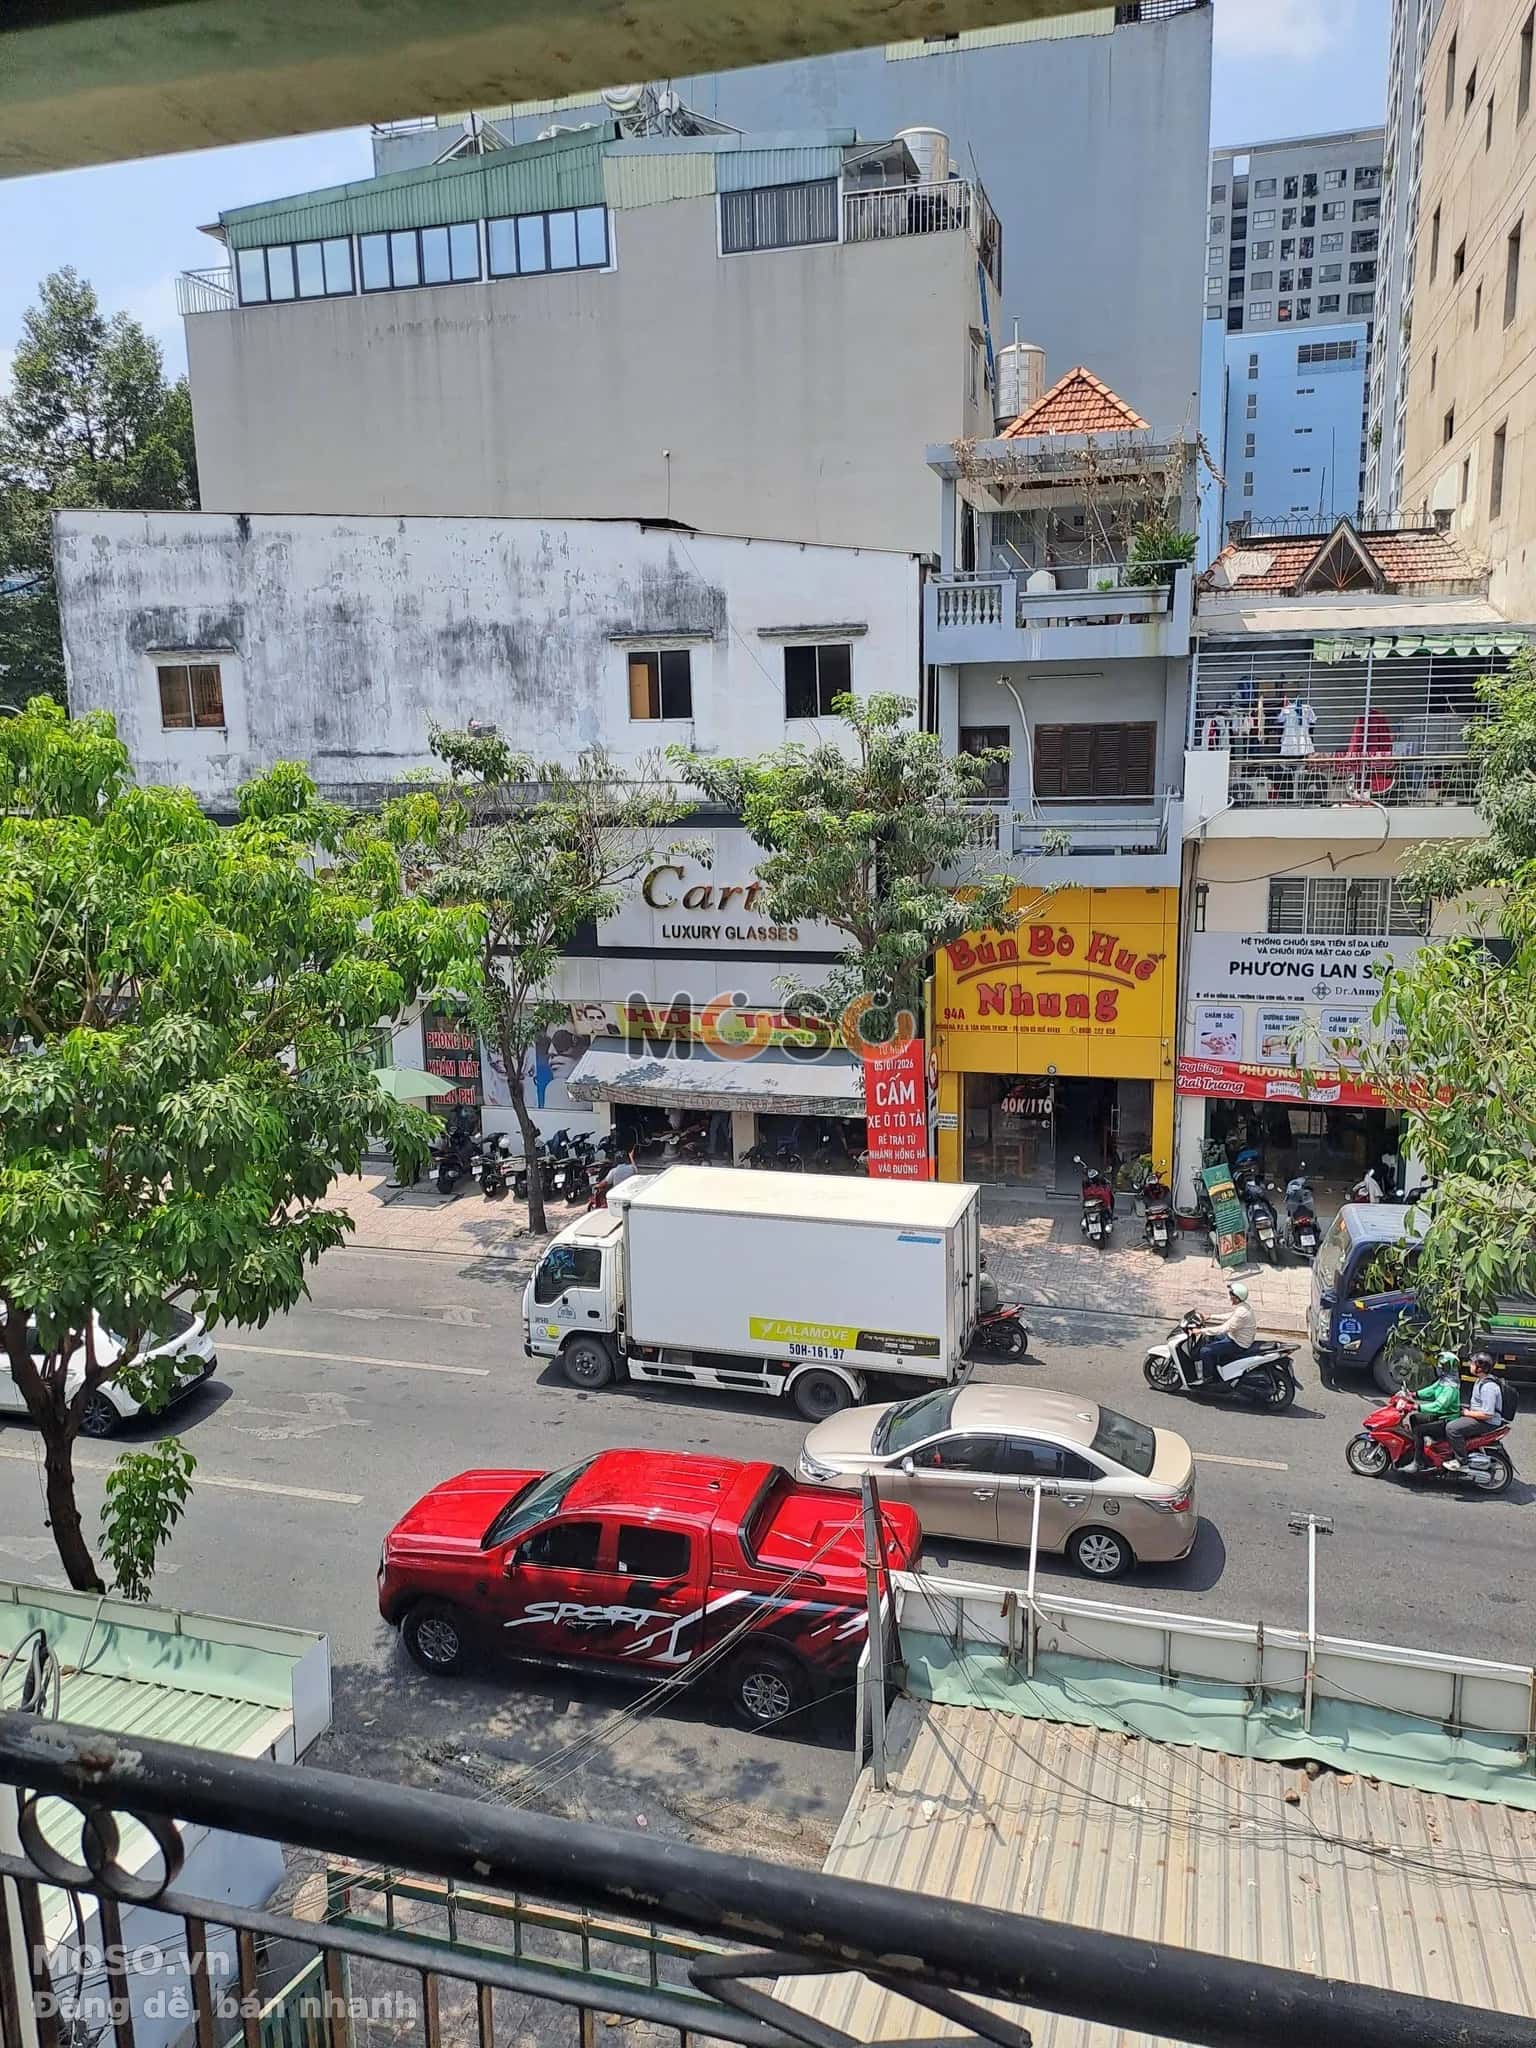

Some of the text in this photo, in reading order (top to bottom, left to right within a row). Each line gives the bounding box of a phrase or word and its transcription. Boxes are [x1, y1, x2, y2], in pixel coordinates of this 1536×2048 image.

[642, 864, 763, 913] Cart
[662, 924, 799, 942] LUXURY GLASSES
[1254, 937, 1281, 946] THỐNG
[1310, 939, 1326, 947] SPA
[1358, 940, 1369, 949] DA
[946, 924, 1167, 982] Bún Bò Huế
[1229, 961, 1314, 977] PHƯƠNG
[1320, 964, 1357, 979] LAN
[976, 983, 1119, 1023] Nhung
[943, 1007, 965, 1020] 94A
[1239, 1065, 1298, 1079] PHƯƠNG
[875, 1073, 915, 1106] CẤM
[868, 1115, 881, 1129] XE
[884, 1112, 891, 1127] Ô
[894, 1112, 907, 1127] TÔ
[909, 1109, 925, 1126] TẢI
[776, 1323, 850, 1342] LALAMOVE
[789, 1343, 844, 1360] 50H-161.97
[503, 1601, 682, 1632] SPORT
